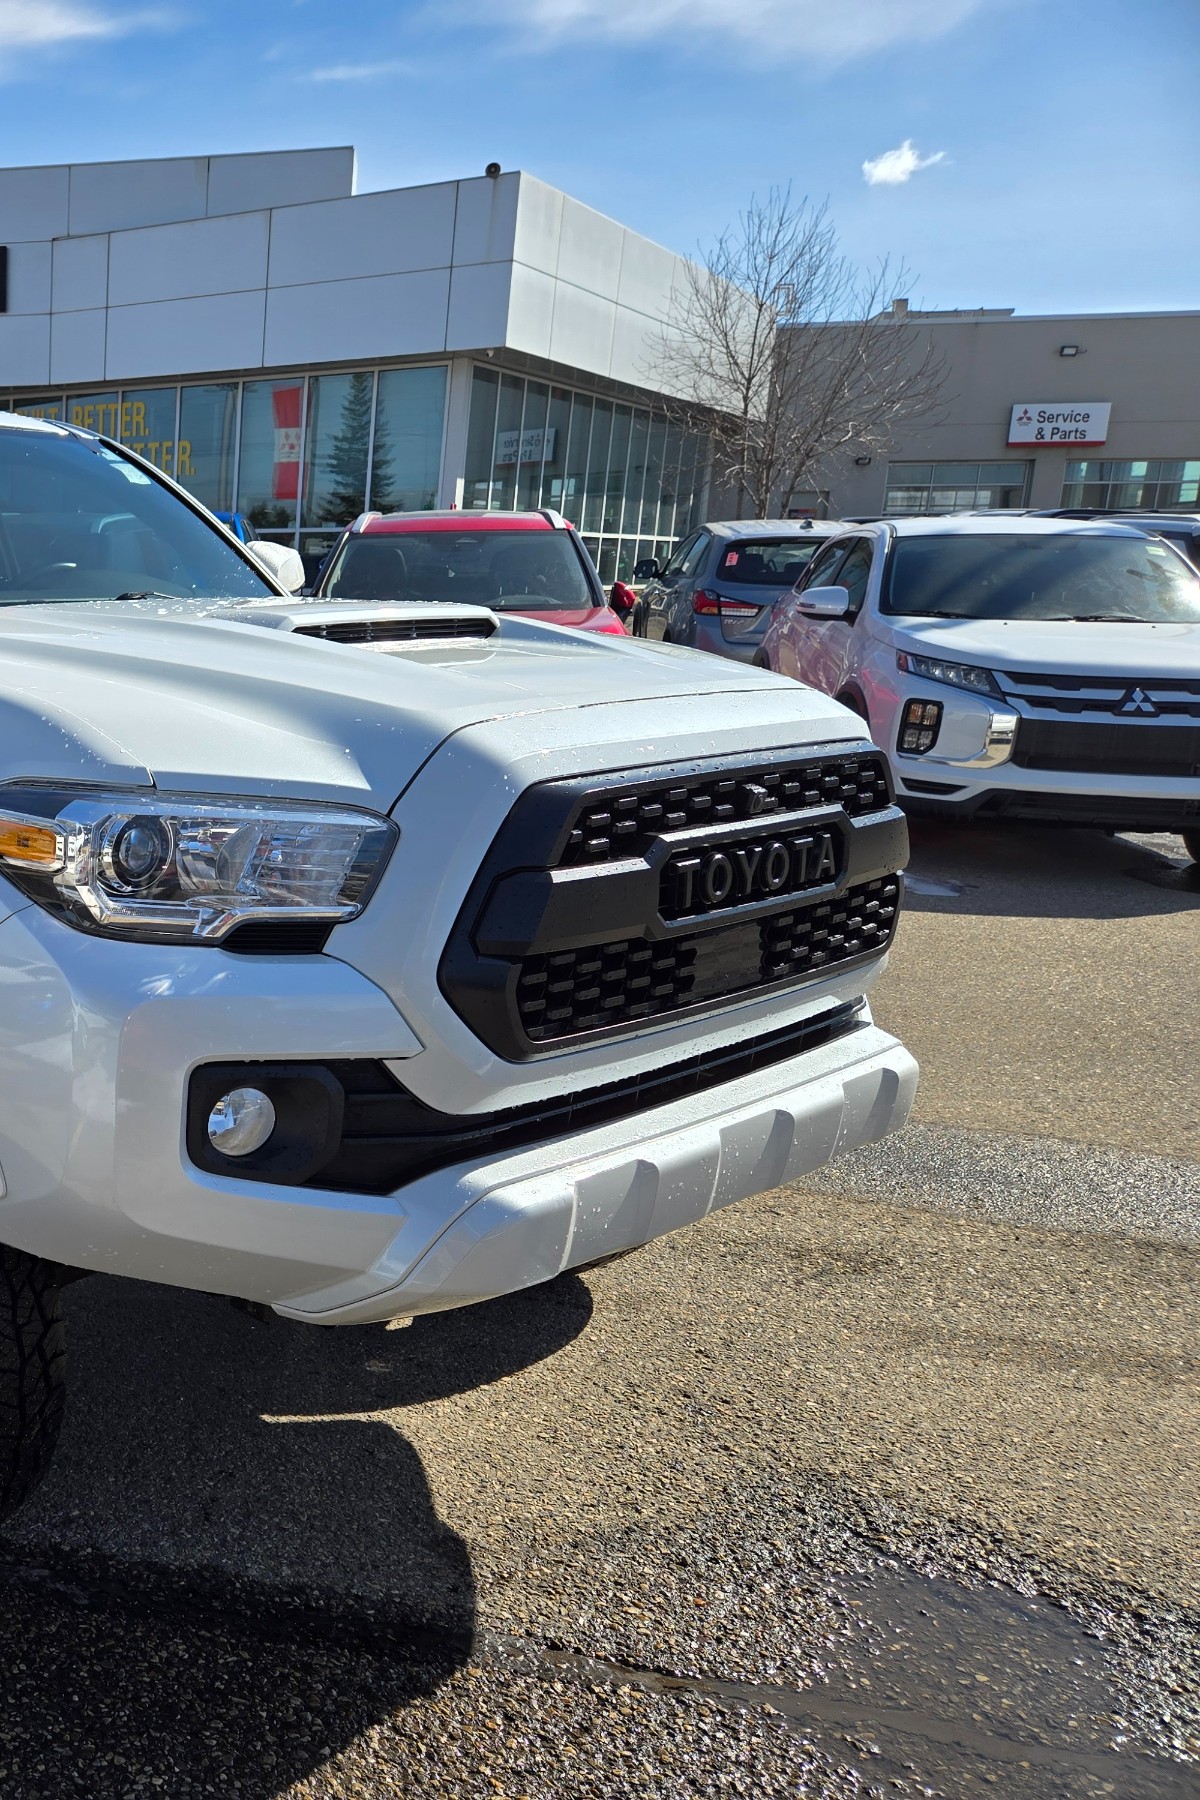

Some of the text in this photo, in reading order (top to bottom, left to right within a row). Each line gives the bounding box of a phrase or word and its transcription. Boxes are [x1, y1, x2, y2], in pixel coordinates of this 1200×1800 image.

[1036, 410, 1090, 424] Service
[1034, 427, 1087, 441] & Parts
[670, 832, 836, 909] TOYOTA
